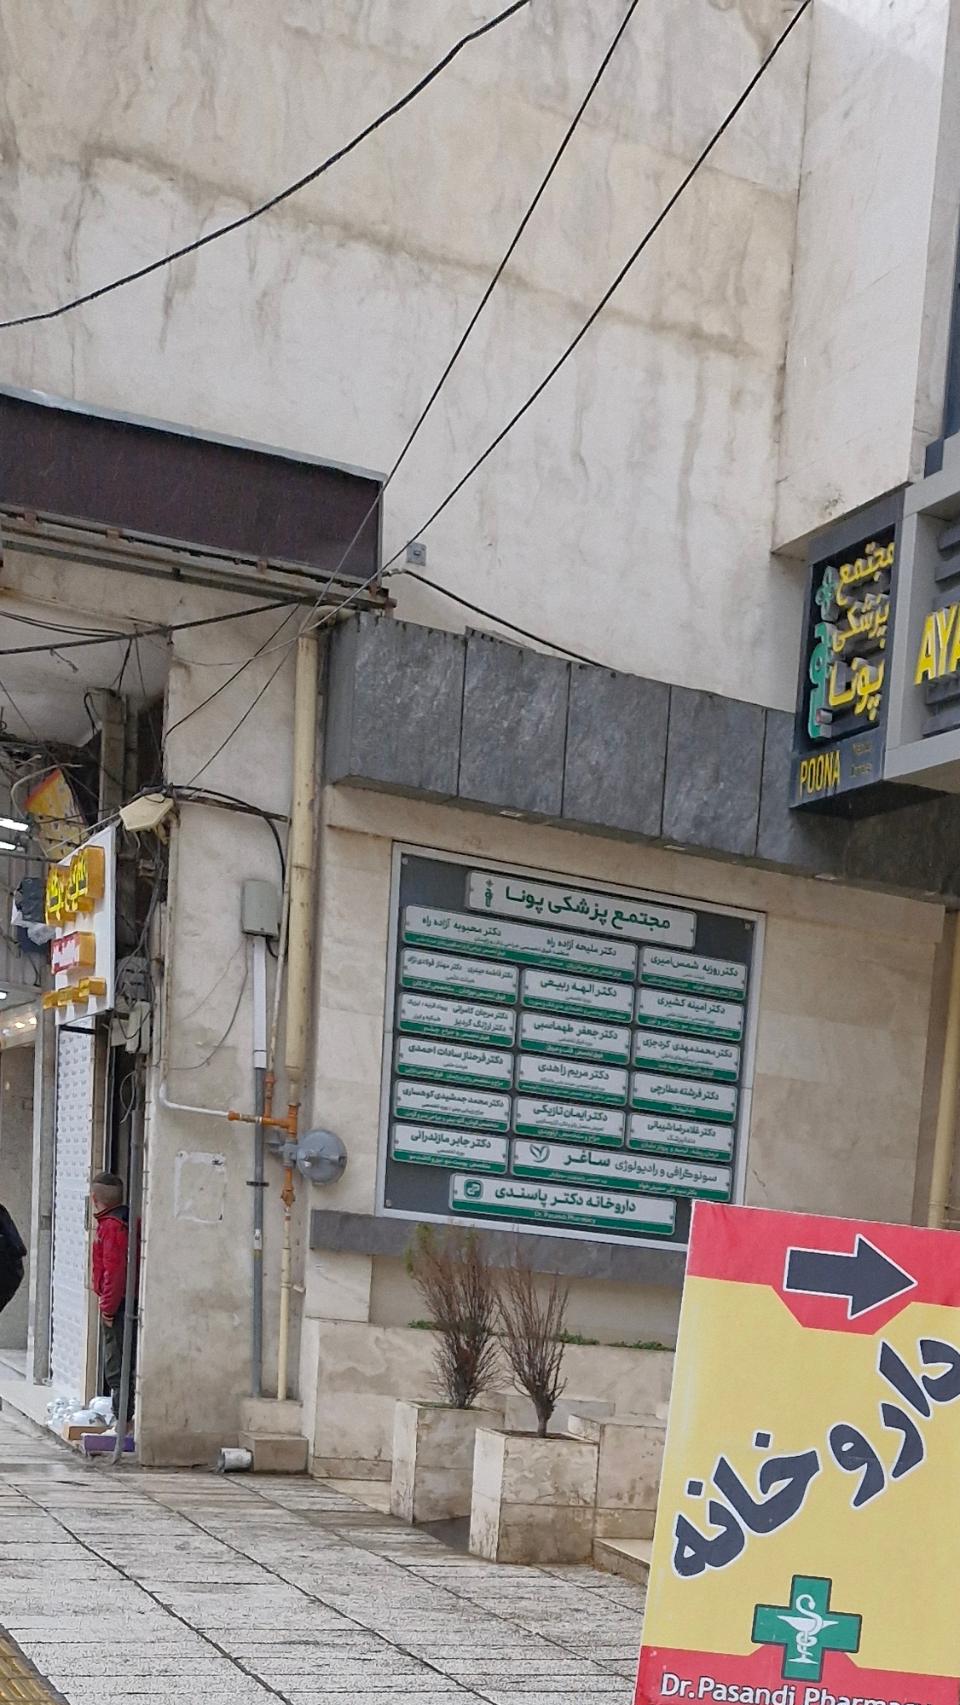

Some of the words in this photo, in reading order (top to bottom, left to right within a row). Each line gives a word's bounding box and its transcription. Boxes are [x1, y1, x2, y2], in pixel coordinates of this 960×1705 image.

[837, 542, 895, 606] مجتمع
[832, 593, 890, 653] پزشکی
[829, 657, 885, 721] پونا
[800, 750, 841, 800] POONA
[505, 886, 544, 915] پونا
[548, 896, 608, 923] پزشکی
[611, 909, 671, 931] مجتمع
[453, 922, 482, 933] محبوبه
[482, 927, 502, 937] دکتر
[599, 947, 617, 956] دکتر
[449, 963, 462, 971] دکتر
[702, 964, 721, 976] روزبه
[719, 967, 738, 977] دکتر
[500, 971, 513, 979] دکتر
[540, 979, 570, 992] ربیعی
[571, 982, 594, 995] الهه
[594, 986, 617, 997] دکتر
[657, 997, 686, 1008] کشیری
[687, 1001, 707, 1013] امینه
[706, 1004, 725, 1014] دکتر
[494, 1012, 508, 1020] دکتر
[491, 1024, 506, 1032] دکتر
[533, 1021, 574, 1034] طهماسبی
[576, 1025, 599, 1039] جعفر
[598, 1030, 618, 1040] دکتر
[408, 1045, 436, 1054] احمدی
[437, 1048, 462, 1058] سادات
[715, 1049, 733, 1059] دکتر
[461, 1051, 486, 1063] فرحناز
[485, 1055, 503, 1065] دکتر
[537, 1064, 567, 1076] زاهدی
[567, 1069, 589, 1079] مریم
[588, 1070, 610, 1080] دکتر
[679, 1088, 702, 1100] فرشته
[701, 1091, 719, 1101] دکتر
[468, 1097, 488, 1106] محمد
[488, 1099, 504, 1108] دکتر
[563, 1108, 587, 1121] ایمان
[585, 1110, 608, 1122] دکتر
[410, 1130, 450, 1145] مازندرانی
[698, 1128, 716, 1137] دکتر
[449, 1136, 471, 1148] جابر
[470, 1138, 491, 1149] دکتر
[563, 1149, 612, 1167] ساغر
[614, 1160, 659, 1177] رادیولوژی
[659, 1168, 665, 1178] و
[666, 1168, 717, 1184] سونوگرافی
[495, 1187, 548, 1208] پاسندی
[550, 1192, 584, 1206] دکتر
[586, 1196, 636, 1213] داروخانه
